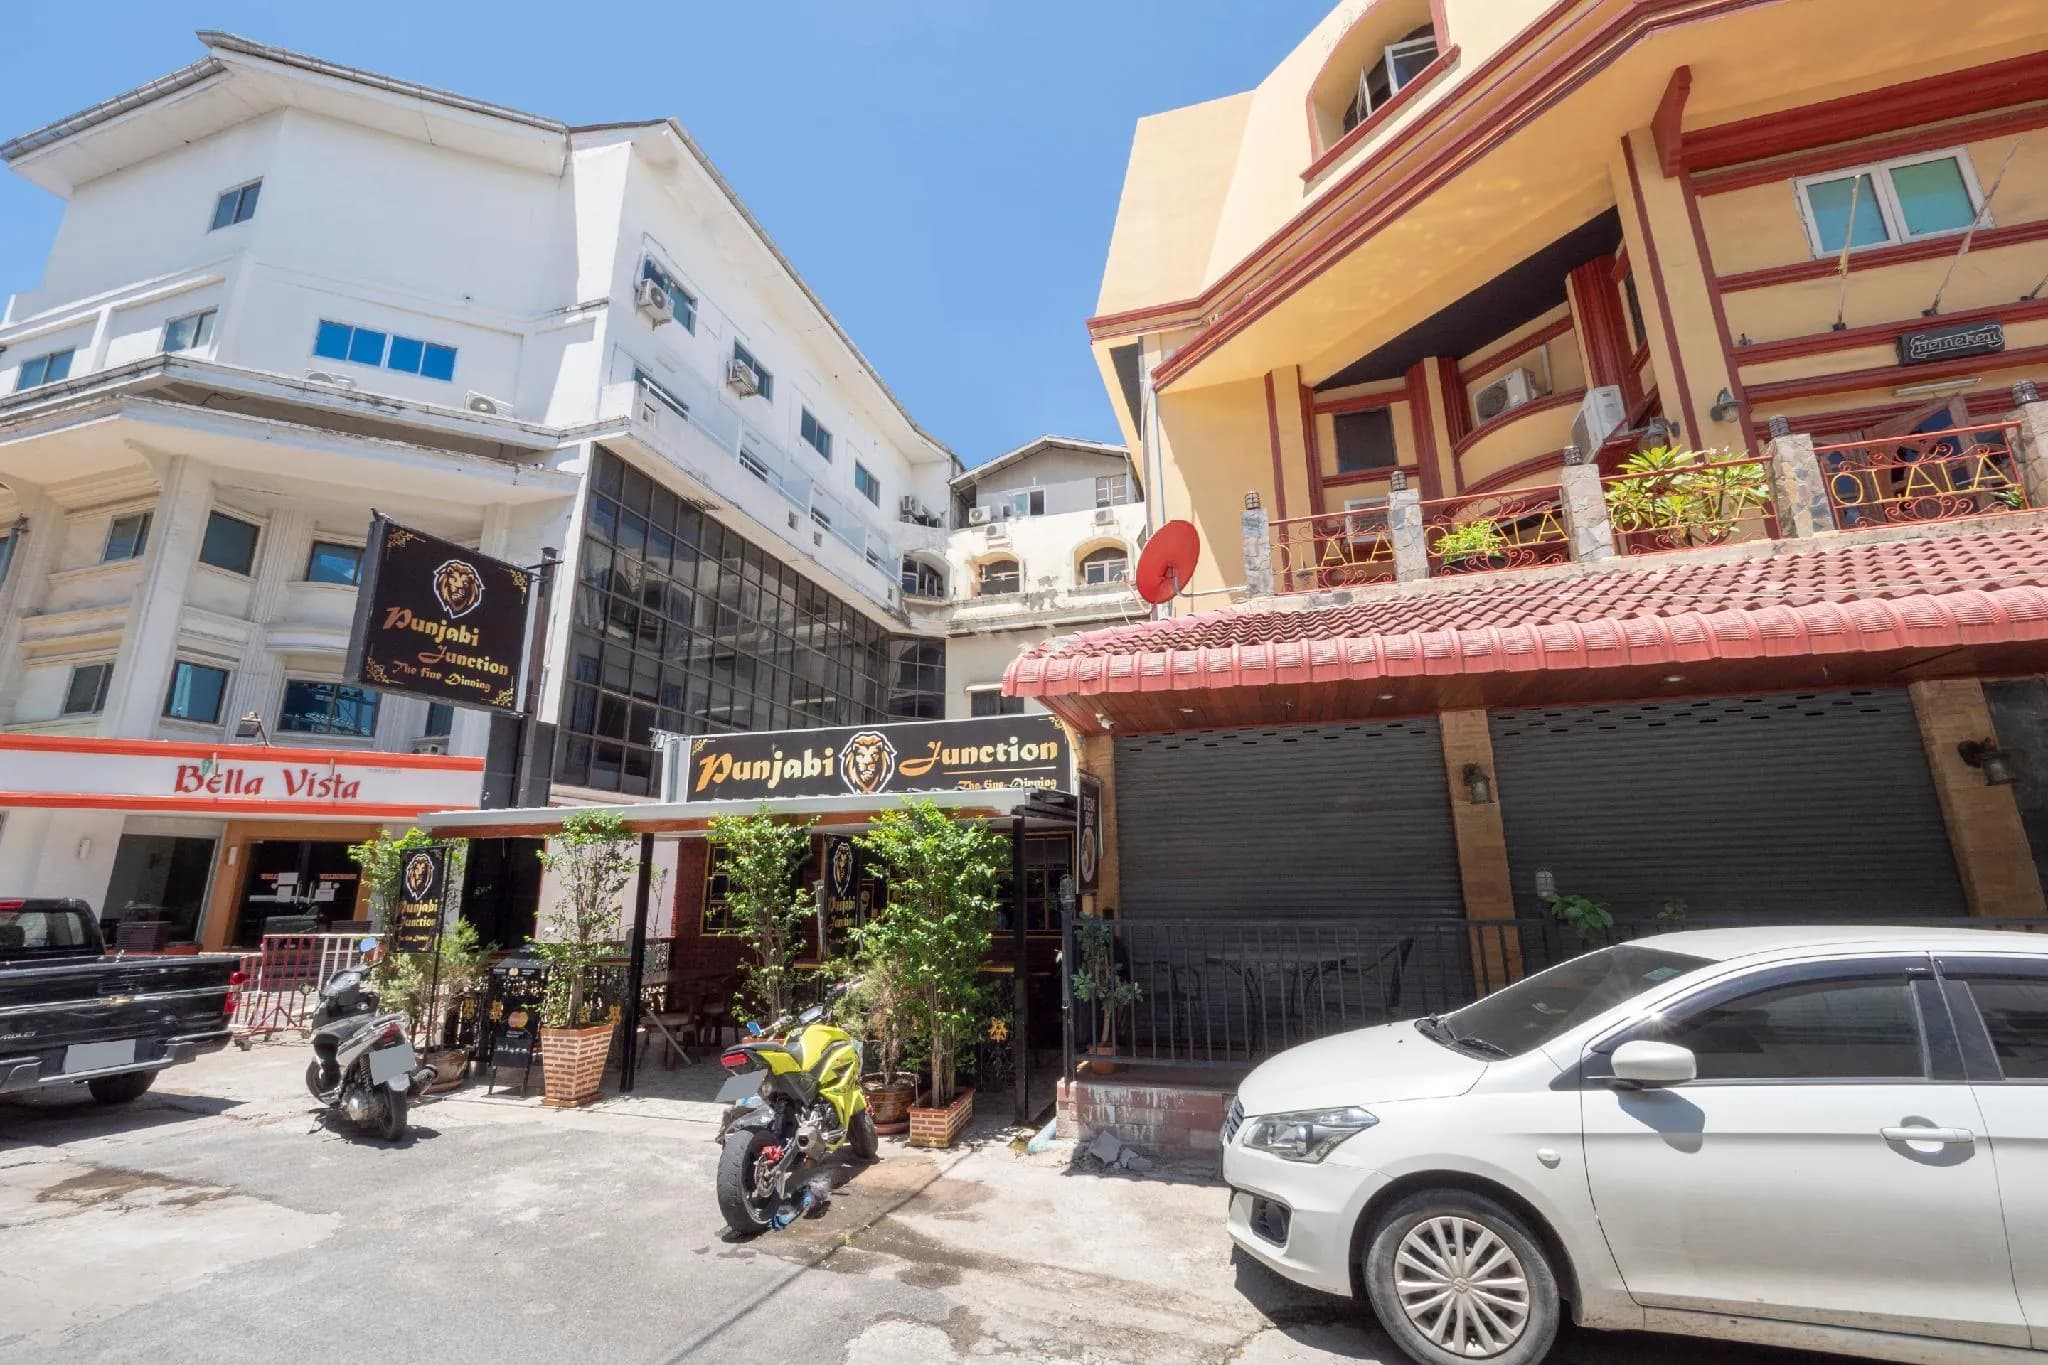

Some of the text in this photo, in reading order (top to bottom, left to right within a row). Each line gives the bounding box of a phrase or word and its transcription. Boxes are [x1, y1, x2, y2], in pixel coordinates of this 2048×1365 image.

[383, 606, 480, 646] Punjabi
[392, 660, 417, 675] The
[445, 672, 492, 693] Dinning
[418, 645, 509, 676] Junction
[695, 736, 1058, 793] Punjabi Junction
[174, 765, 361, 799] Bella Vista
